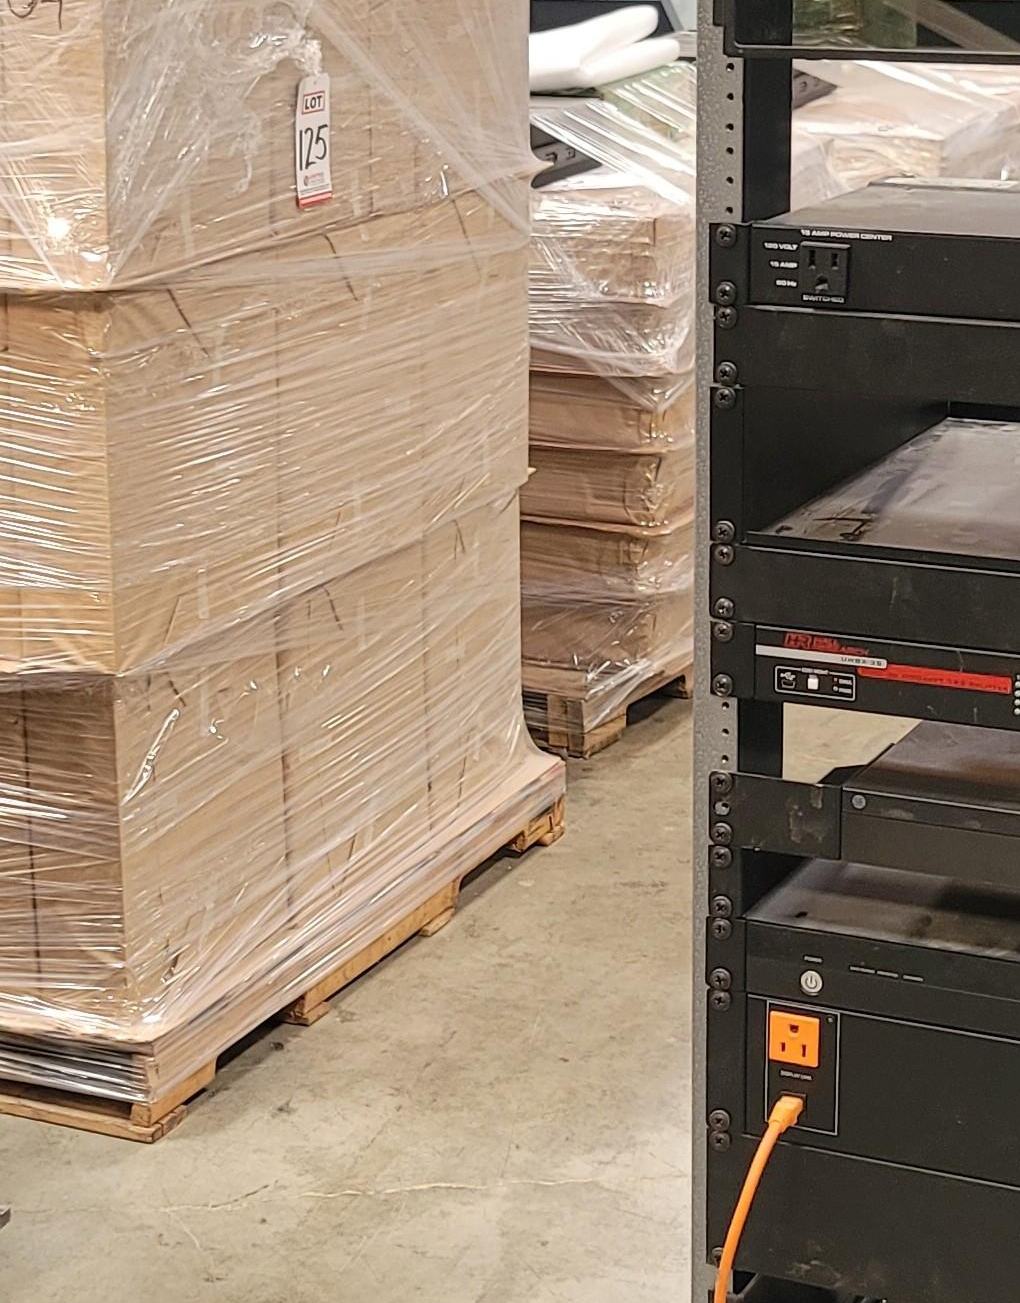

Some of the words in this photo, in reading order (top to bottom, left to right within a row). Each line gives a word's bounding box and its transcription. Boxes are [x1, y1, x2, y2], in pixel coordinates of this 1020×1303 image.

[304, 95, 323, 110] LOT
[299, 124, 329, 171] 125
[811, 230, 830, 238] AMP
[830, 231, 860, 240] POWER
[860, 232, 893, 241] CENTER
[802, 294, 845, 303] SWITCHED
